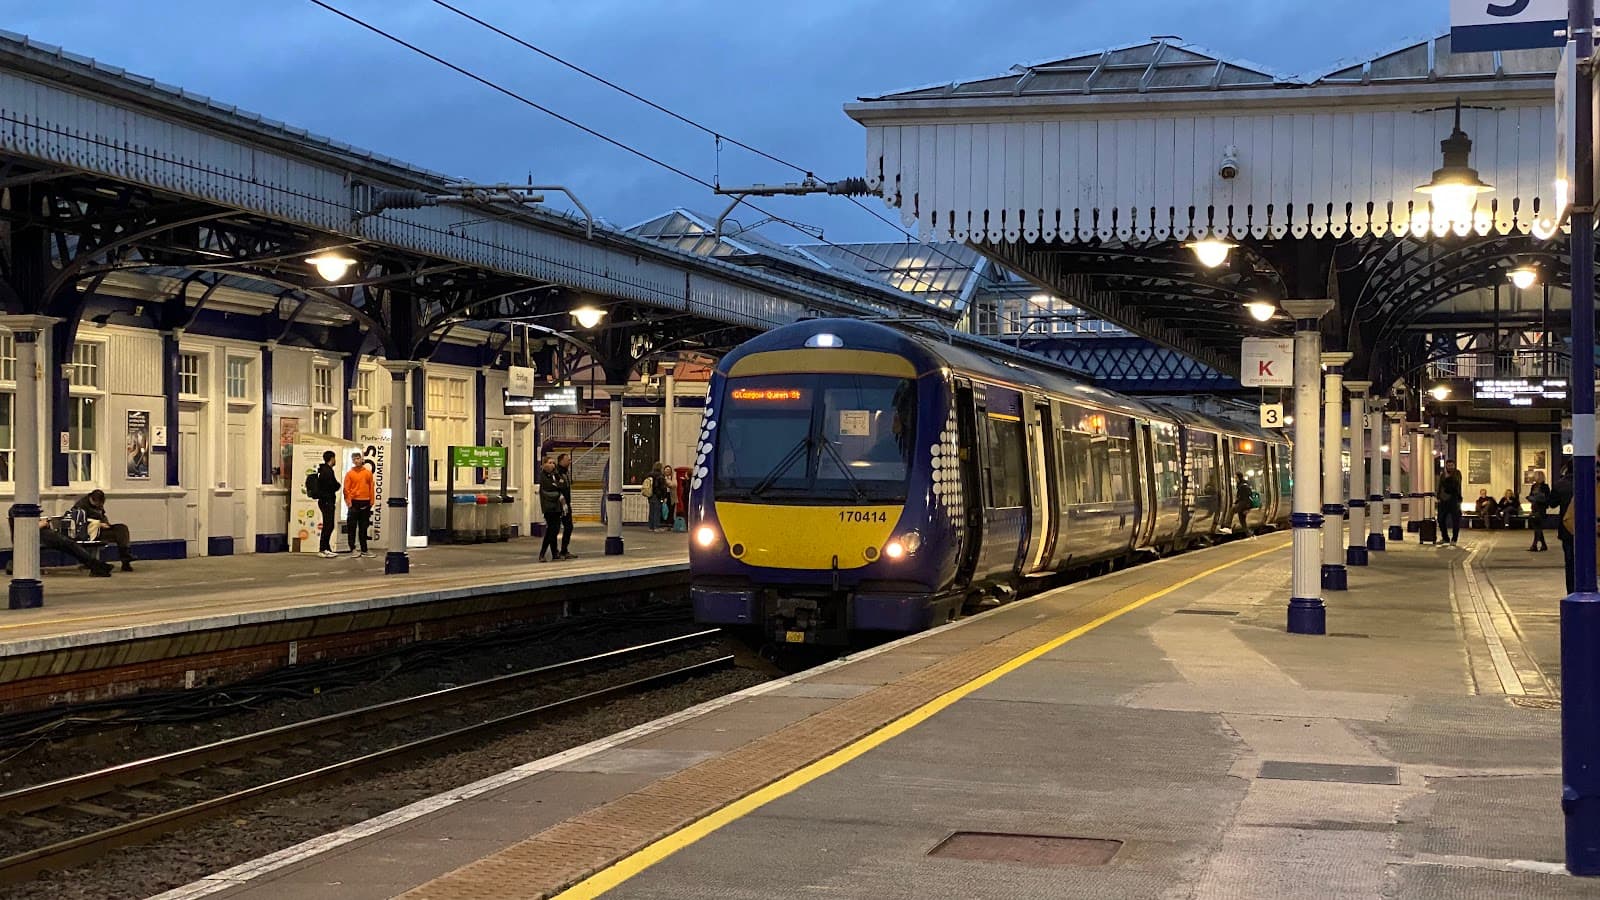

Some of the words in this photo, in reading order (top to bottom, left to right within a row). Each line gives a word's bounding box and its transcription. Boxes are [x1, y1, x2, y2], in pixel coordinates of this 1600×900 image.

[1259, 360, 1274, 376] K
[733, 390, 764, 400] Glasgow
[766, 390, 789, 400] Queen
[790, 389, 801, 400] St
[1266, 409, 1278, 424] 3
[376, 445, 384, 501] DOCUMENTS
[373, 503, 382, 541] OFFICIAL
[839, 511, 887, 523] 170414
